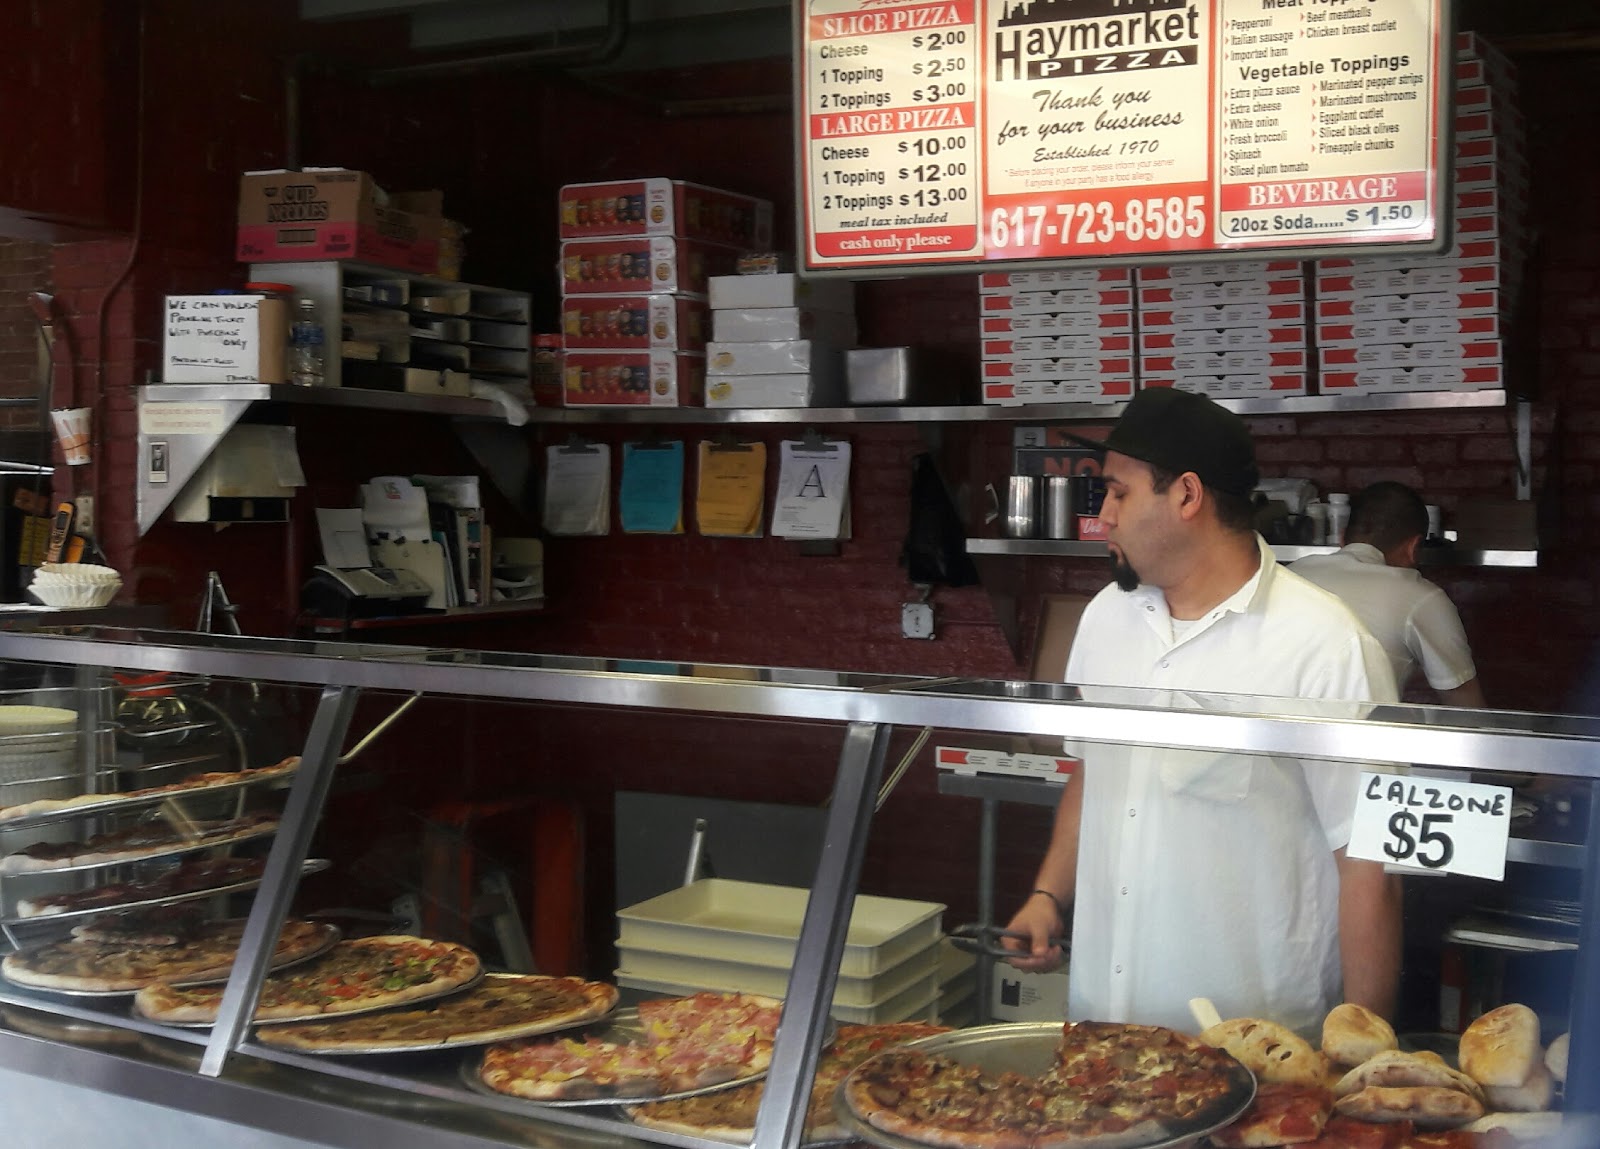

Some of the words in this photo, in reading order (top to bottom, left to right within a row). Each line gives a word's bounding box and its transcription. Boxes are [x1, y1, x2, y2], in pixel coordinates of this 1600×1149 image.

[823, 13, 888, 38] SLICE
[892, 5, 961, 30] PIZZA
[1307, 12, 1327, 22] Beef
[1329, 7, 1372, 20] meatballs
[1231, 16, 1272, 32] Pepperoni
[1306, 26, 1339, 38] Chicken
[1342, 24, 1370, 35] breast
[1372, 20, 1397, 32] cutlet
[996, 4, 1200, 81] Haymarket
[1231, 34, 1257, 45] Italian
[1259, 31, 1294, 44] sausage
[820, 45, 868, 58] Cheese
[1230, 48, 1267, 62] Imported
[1270, 47, 1288, 58] ham
[1040, 50, 1186, 76] PIZZA
[1240, 60, 1324, 82] Vegetable
[1330, 54, 1410, 74] Toppings
[820, 70, 826, 83] 1
[832, 67, 883, 84] Topping
[1320, 79, 1363, 92] Marinated
[1366, 76, 1396, 90] pepper
[1400, 73, 1424, 87] strips
[1032, 86, 1104, 112] Thank
[1112, 90, 1152, 110] you
[1230, 89, 1250, 100] Extra
[1253, 86, 1273, 99] pizza
[1276, 84, 1300, 94] sauce
[1320, 94, 1363, 106] Marinated
[1366, 90, 1416, 104] mushrooms
[820, 95, 828, 108] 2
[832, 91, 891, 110] Toppings
[1230, 104, 1250, 114] Extra
[1253, 102, 1282, 112] cheese
[821, 112, 894, 136] LARGE
[898, 106, 965, 130] PIZZA
[1230, 118, 1253, 129] White
[1256, 117, 1279, 128] onion
[1320, 110, 1356, 124] Eggplant
[1360, 108, 1384, 120] cutlet
[998, 121, 1029, 145] for
[1038, 120, 1086, 140] your
[1094, 110, 1184, 132] business
[1319, 126, 1346, 138] Sliced
[1348, 124, 1371, 136] black
[1374, 122, 1400, 134] olives
[1230, 134, 1252, 144] Fresh
[1254, 131, 1287, 143] broccoli
[822, 147, 870, 160] Cheese
[1033, 144, 1111, 162] Established
[1120, 140, 1160, 155] 1970
[1319, 141, 1362, 154] Pineapple
[1365, 138, 1394, 150] chunks
[1229, 148, 1262, 162] Spinach
[1056, 167, 1070, 175] your
[1138, 161, 1152, 170] your
[1229, 165, 1255, 176] Sliced
[1257, 164, 1278, 177] plum
[1280, 162, 1309, 172] tomato
[823, 172, 829, 184] 1
[834, 170, 885, 186] Topping
[1062, 178, 1076, 186] your
[1248, 176, 1398, 206] BEVERAGE
[824, 196, 831, 209] 2
[835, 194, 893, 211] Toppings
[840, 217, 869, 228] meal
[872, 217, 891, 226] tax
[896, 212, 948, 225] included
[990, 196, 1206, 248] 617-723-8585
[1230, 216, 1268, 232] 20oz
[840, 236, 871, 250] cash
[874, 234, 902, 250] only
[906, 233, 952, 250] please
[169, 300, 186, 309] WE
[794, 464, 827, 498] A
[1366, 775, 1505, 816] CALZONE
[1384, 808, 1454, 868] $5
